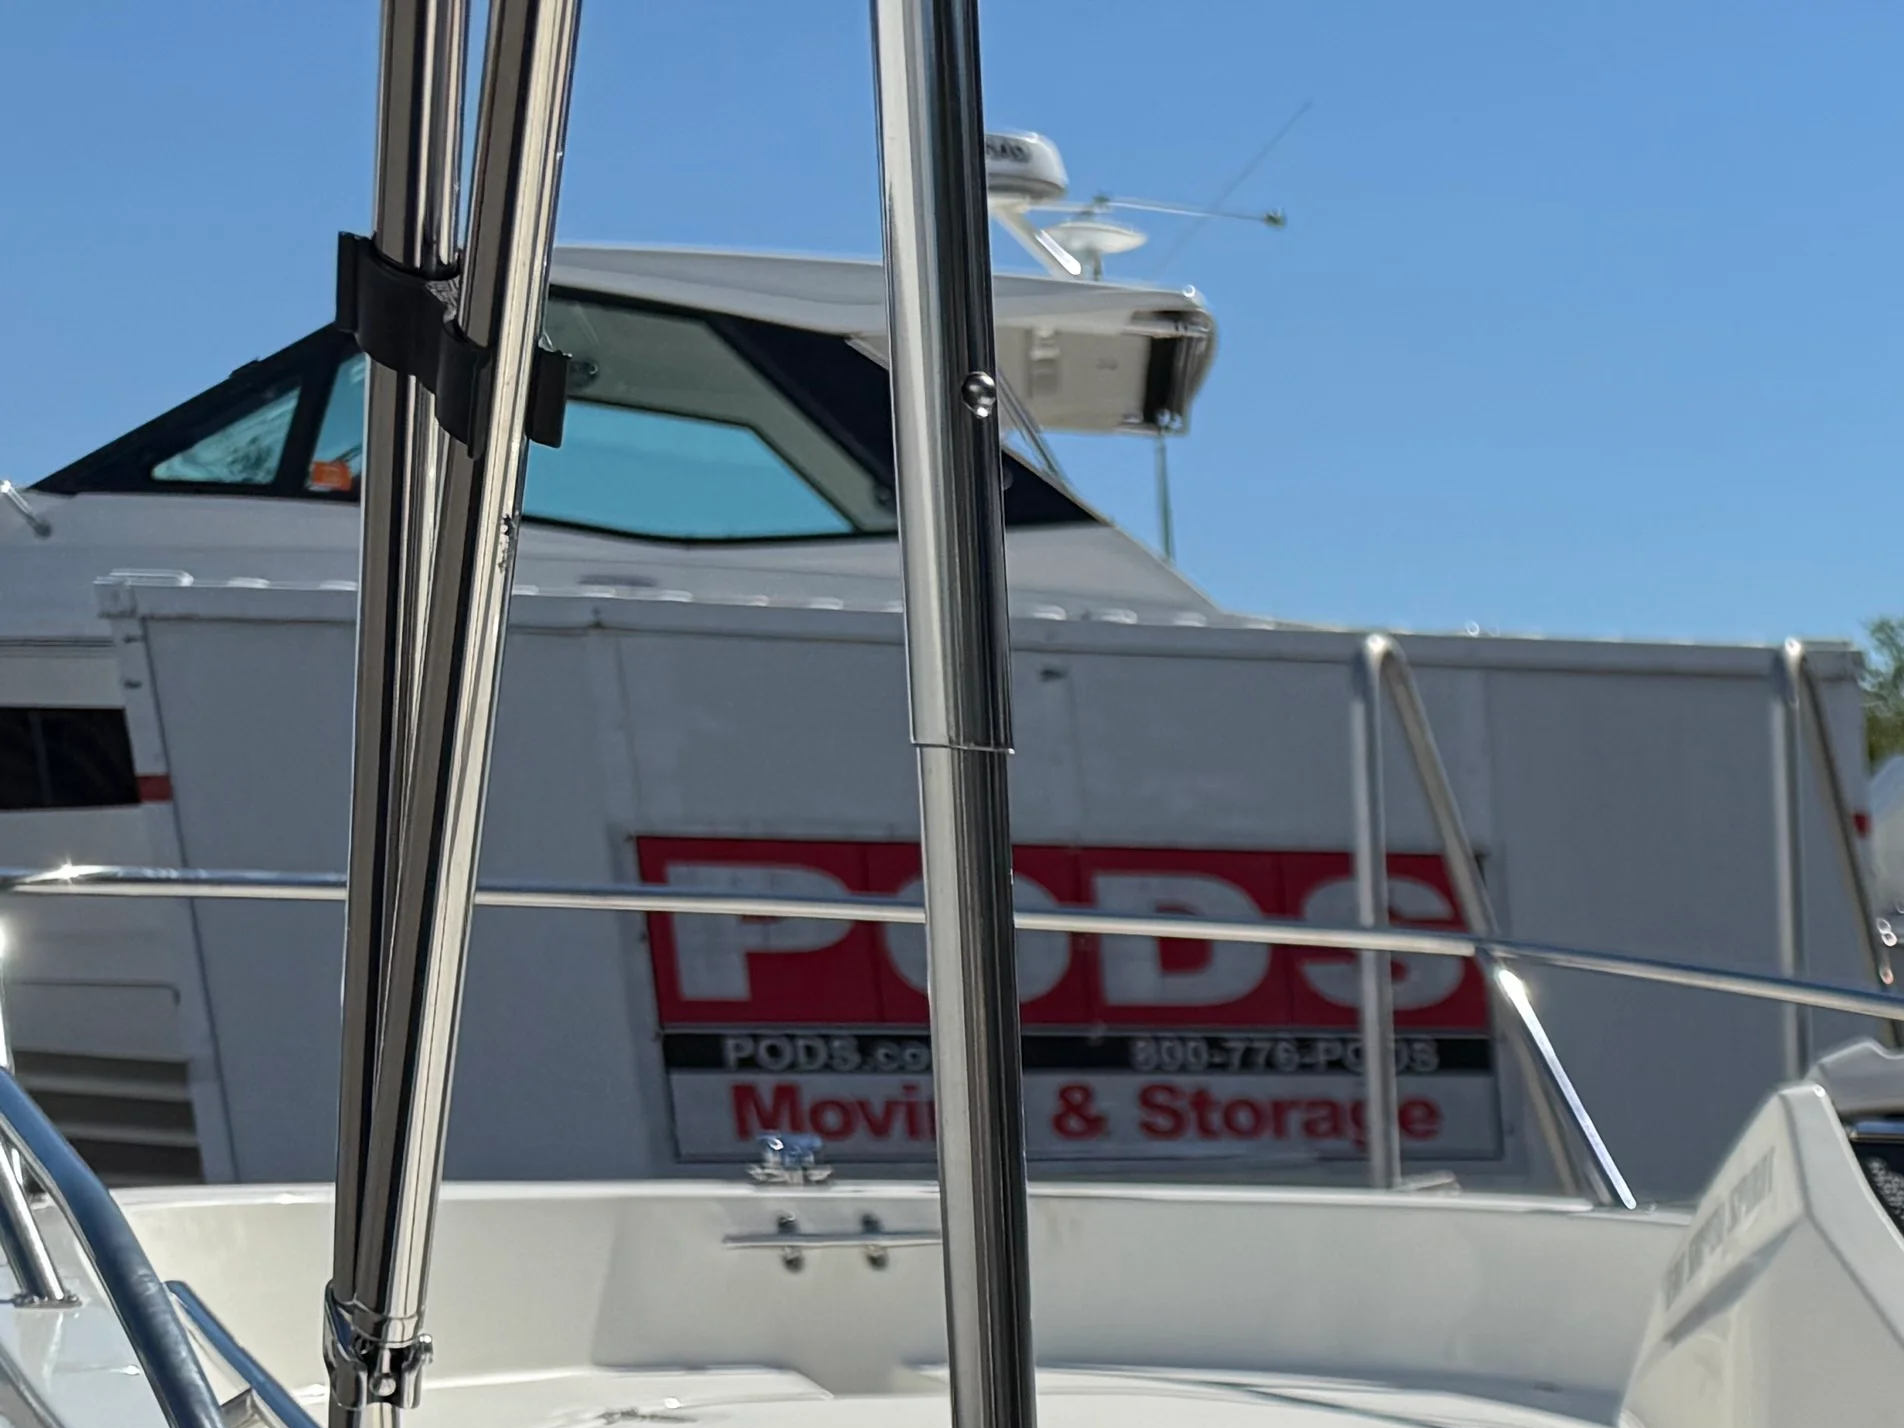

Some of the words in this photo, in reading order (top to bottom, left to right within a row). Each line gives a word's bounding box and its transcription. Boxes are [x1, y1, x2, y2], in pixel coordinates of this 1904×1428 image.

[722, 1036, 932, 1072] PODS.co
[730, 1082, 937, 1141] Movi
[1051, 1082, 1107, 1140] &
